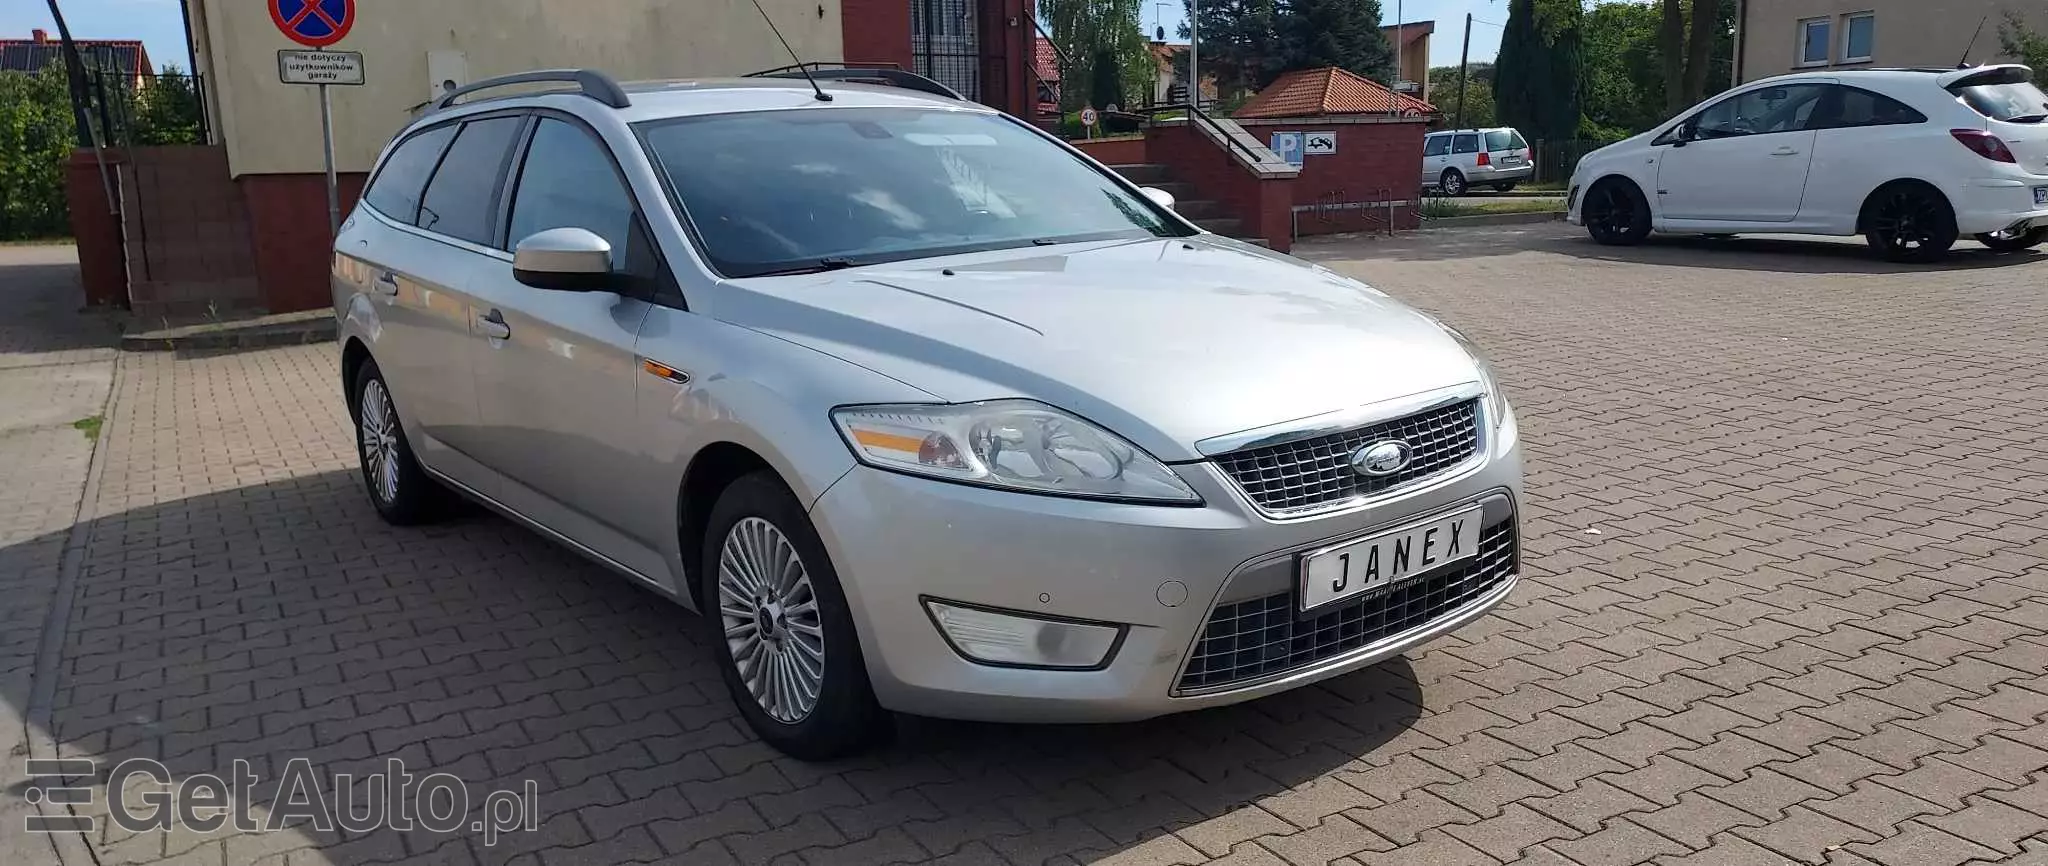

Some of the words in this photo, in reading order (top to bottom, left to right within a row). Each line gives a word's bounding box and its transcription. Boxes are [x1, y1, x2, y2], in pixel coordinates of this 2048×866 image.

[311, 53, 346, 62] dotyczy
[1083, 112, 1095, 121] 40
[1280, 134, 1297, 162] P
[1333, 519, 1464, 593] JANEX
